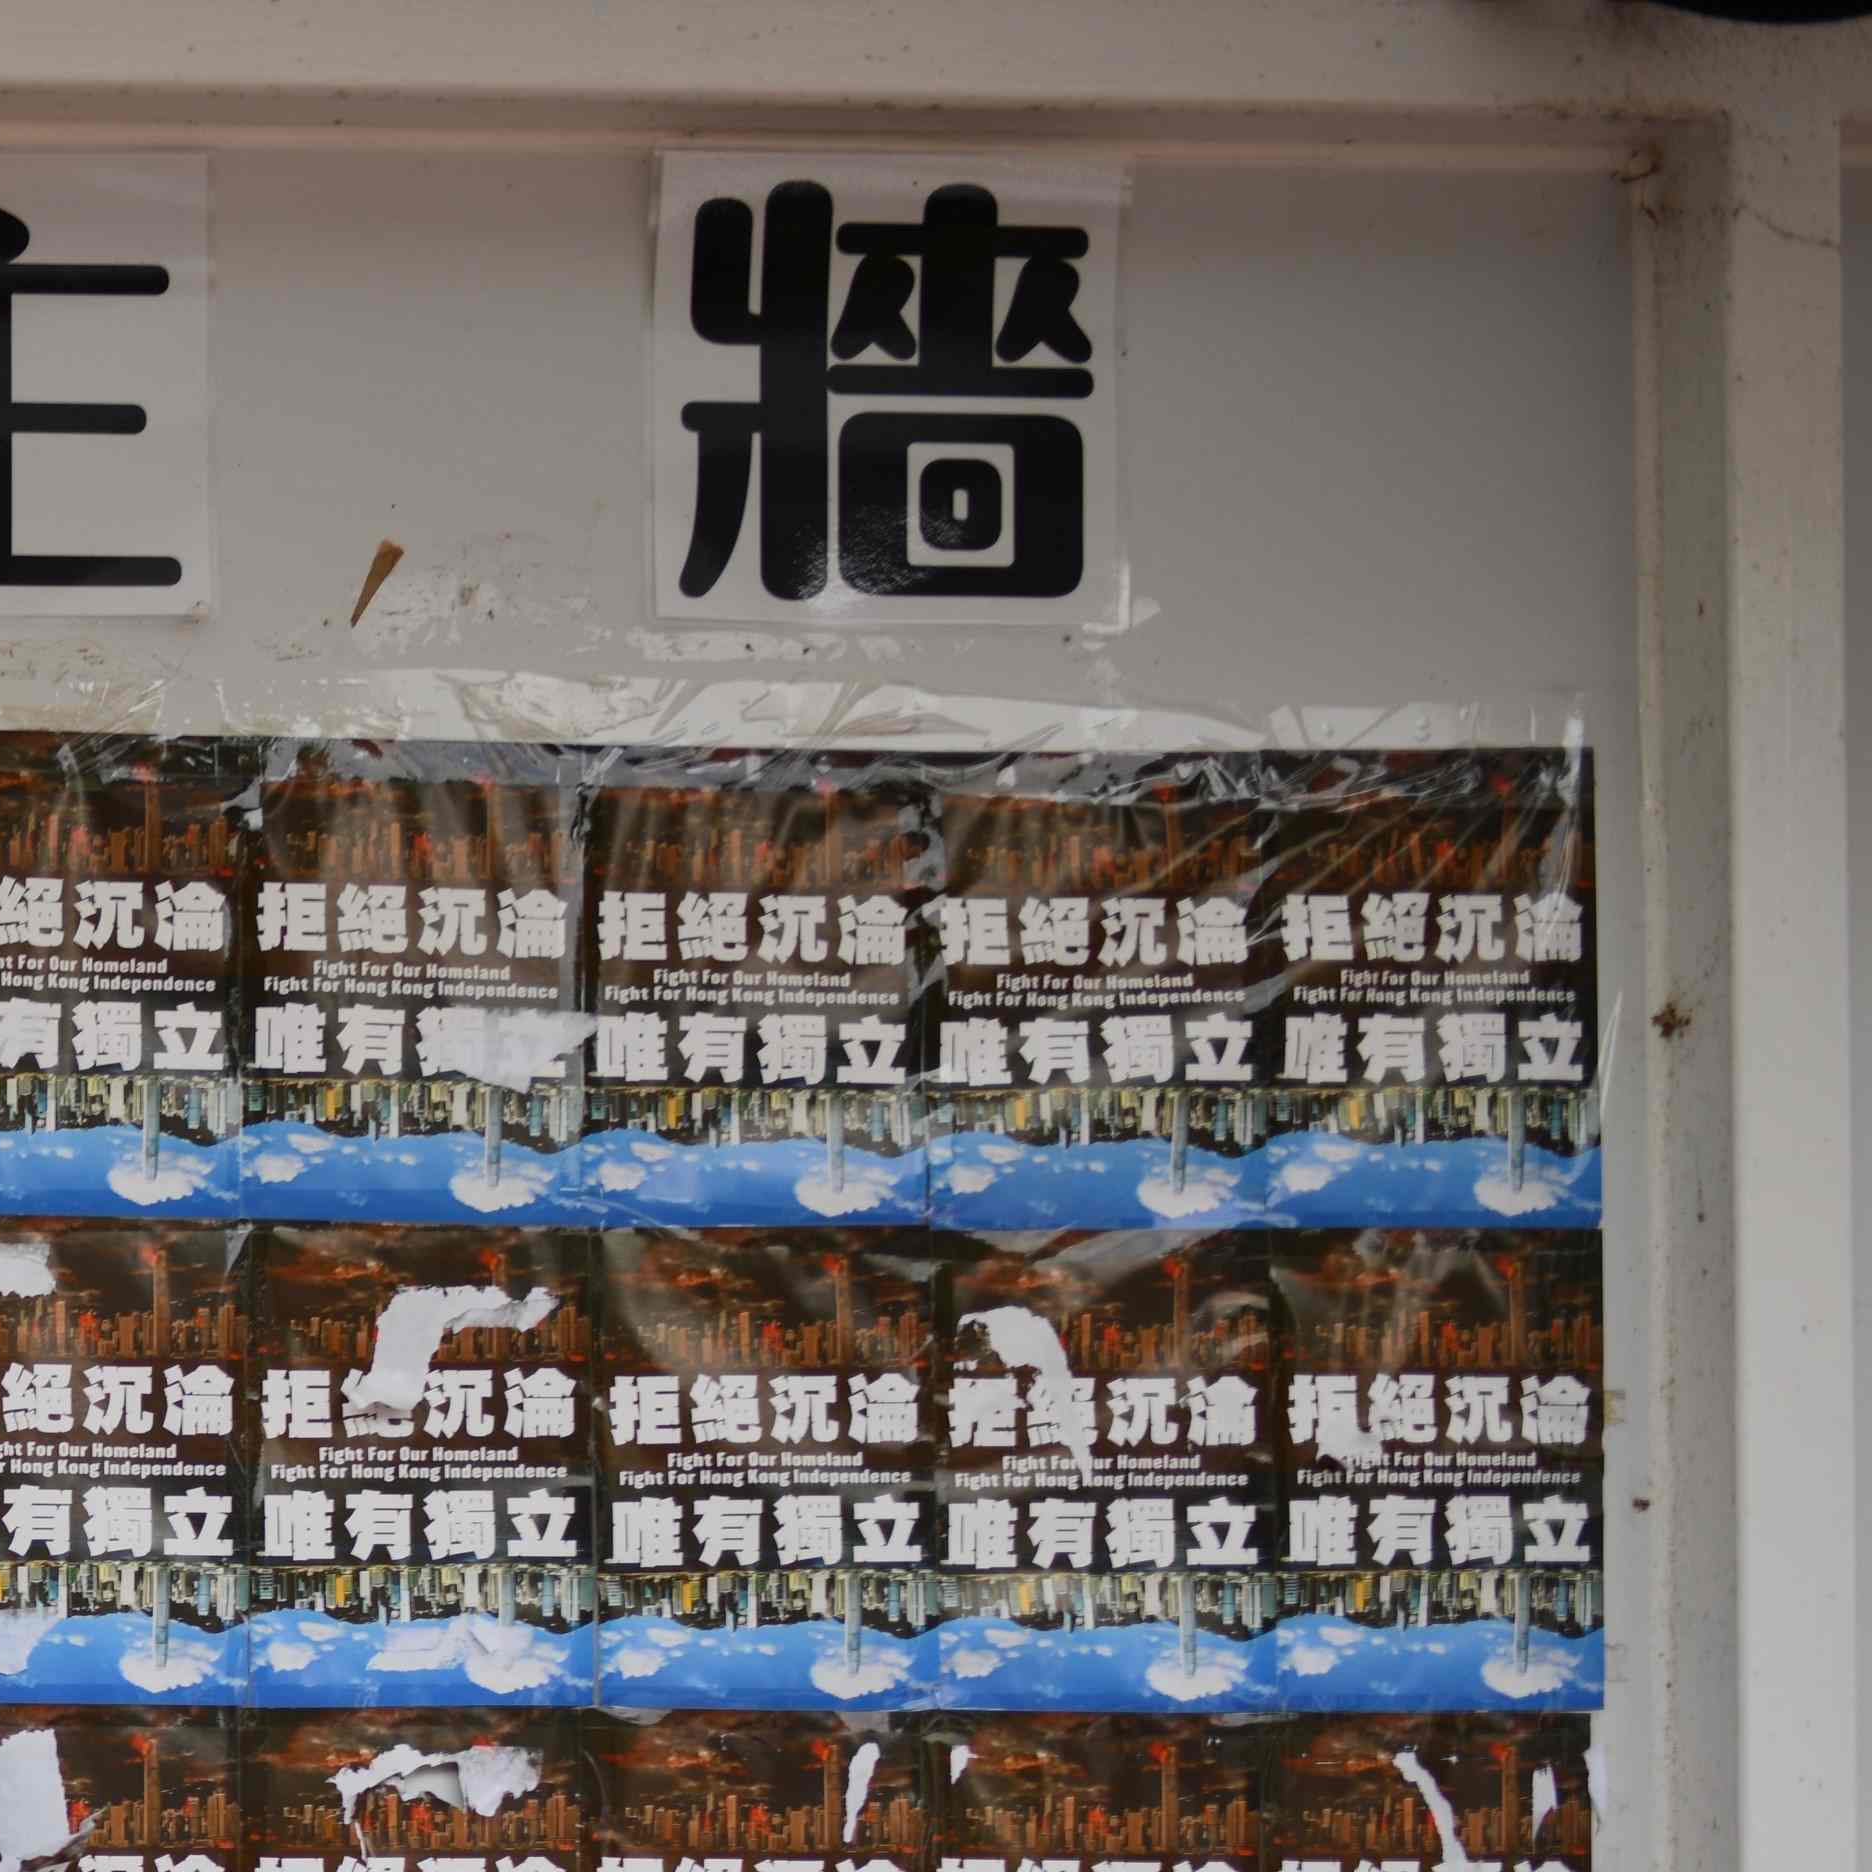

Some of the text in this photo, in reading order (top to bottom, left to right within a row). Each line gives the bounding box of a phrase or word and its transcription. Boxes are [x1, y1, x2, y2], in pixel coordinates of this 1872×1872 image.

[680, 181, 1094, 600] 牆
[598, 891, 907, 965] 拒絕沉淪
[926, 895, 1257, 967] 拒絕沉淪
[596, 1012, 906, 1085] 唯有獨立
[927, 1012, 1252, 1086] 唯有獨立
[609, 1373, 919, 1445] 拒絕沉淪
[607, 1493, 922, 1567] 唯有獨立
